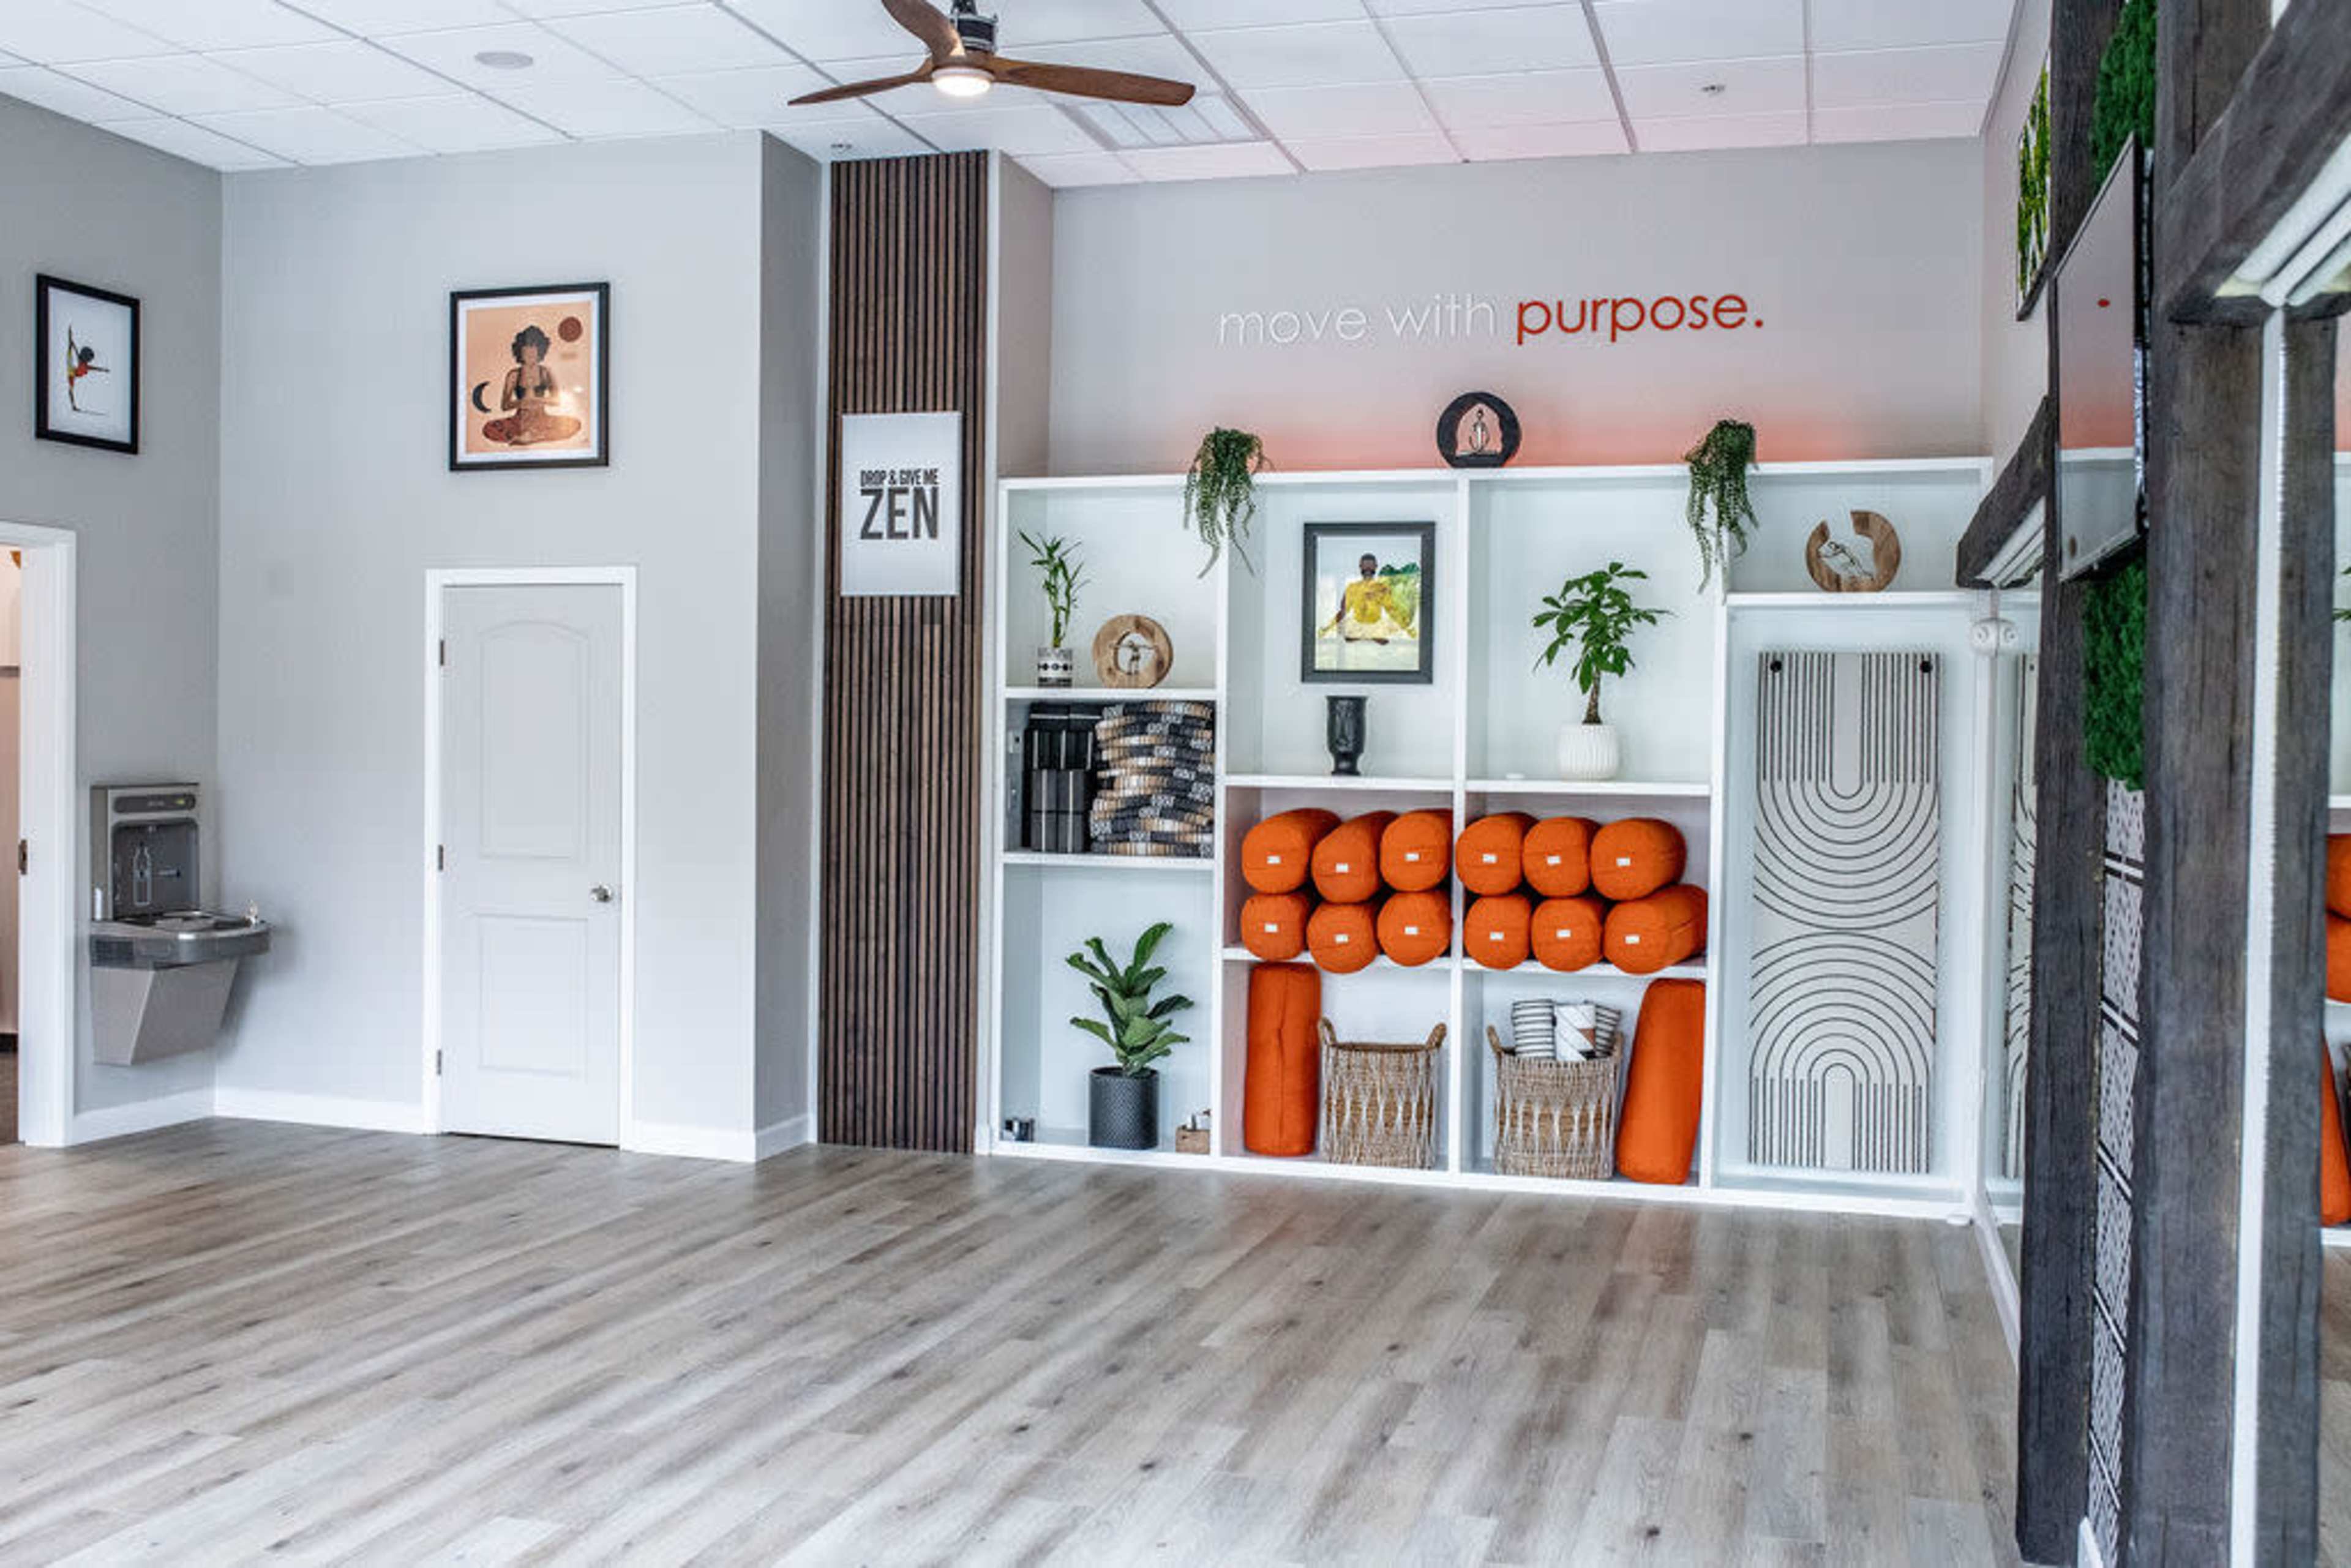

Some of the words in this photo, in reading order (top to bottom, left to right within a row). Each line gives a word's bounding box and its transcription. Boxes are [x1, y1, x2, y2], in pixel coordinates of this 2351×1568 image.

[1219, 308, 1368, 345] move
[1385, 294, 1496, 337] with
[1517, 294, 1764, 346] purpose.
[860, 470, 887, 487] DROP
[888, 469, 896, 484] &
[899, 468, 921, 485] GIVE
[923, 468, 939, 485] ME
[860, 486, 939, 540] ZEN
